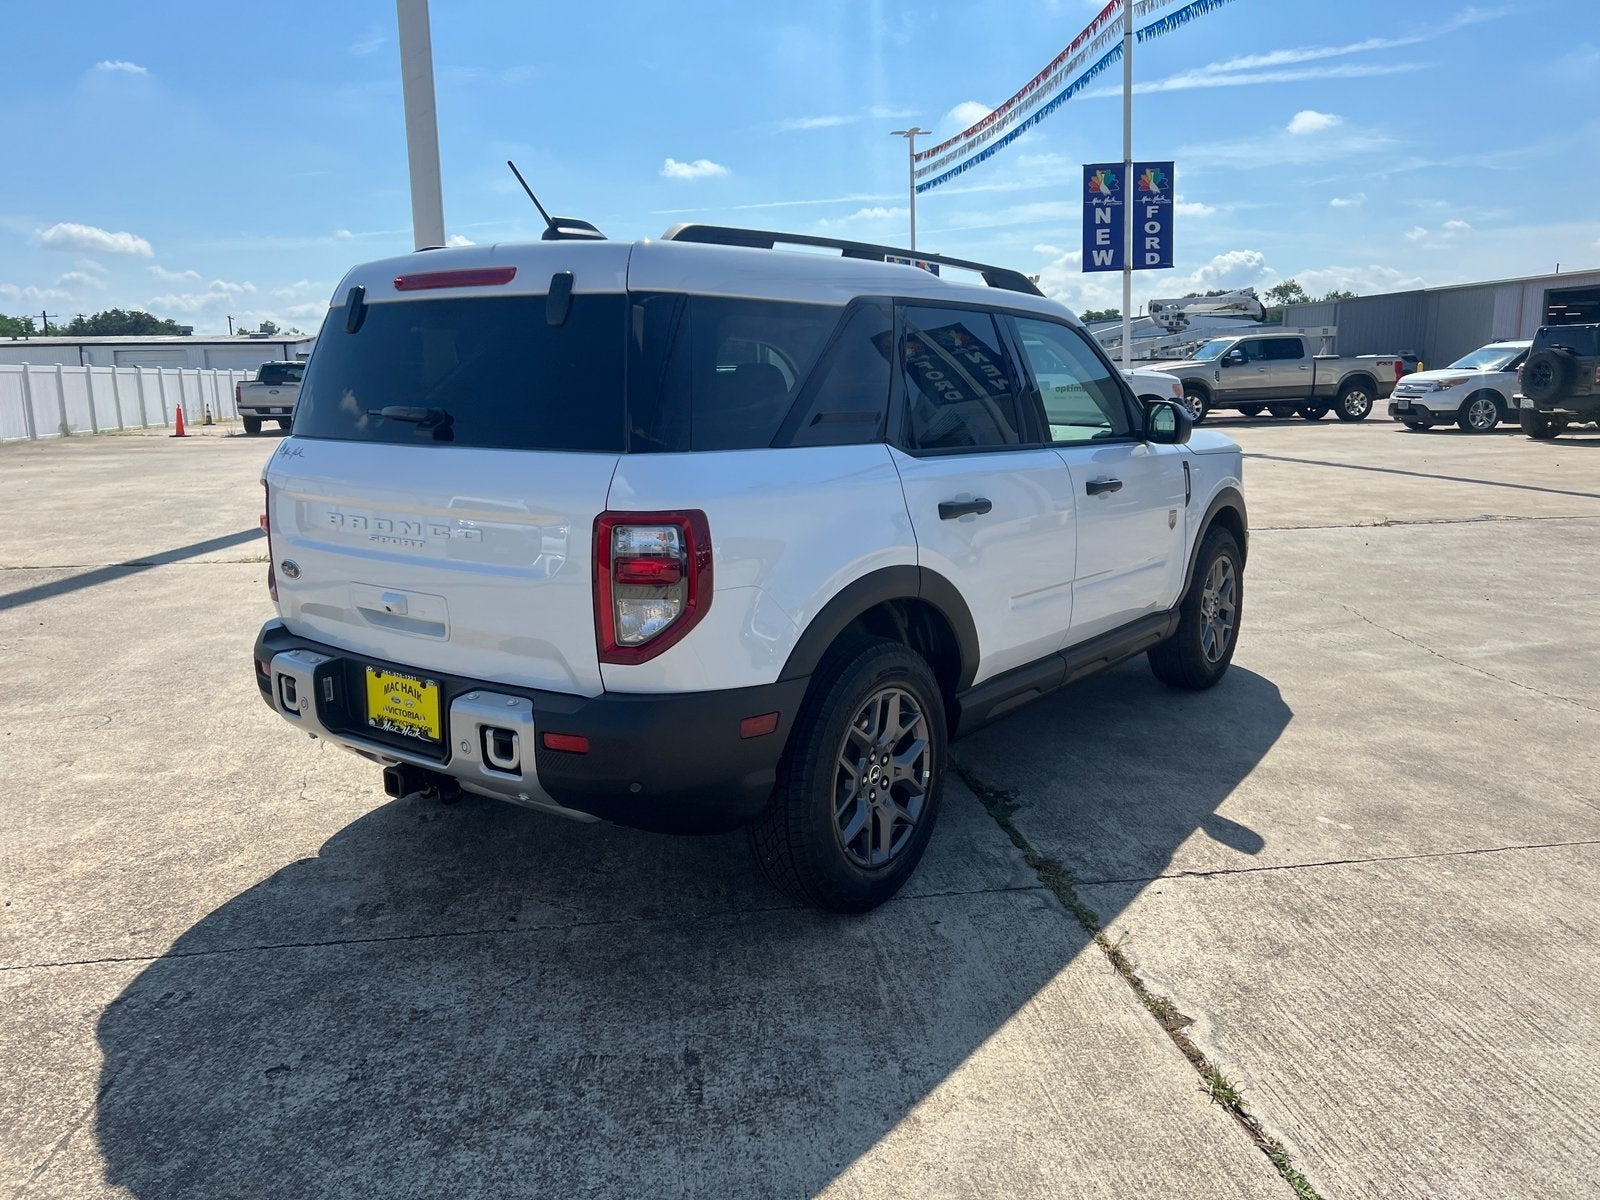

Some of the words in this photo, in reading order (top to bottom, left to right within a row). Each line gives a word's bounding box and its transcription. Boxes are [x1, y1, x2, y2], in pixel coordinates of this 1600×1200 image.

[1092, 207, 1114, 266] NEW
[1144, 205, 1161, 265] FORD
[326, 511, 483, 543] BRONCO
[368, 534, 426, 548] SPORT
[383, 682, 400, 695] MAC
[401, 682, 423, 704] HAIK
[388, 706, 420, 721] VICTORIA
[382, 720, 399, 732] Mac
[401, 726, 421, 737] Haik
